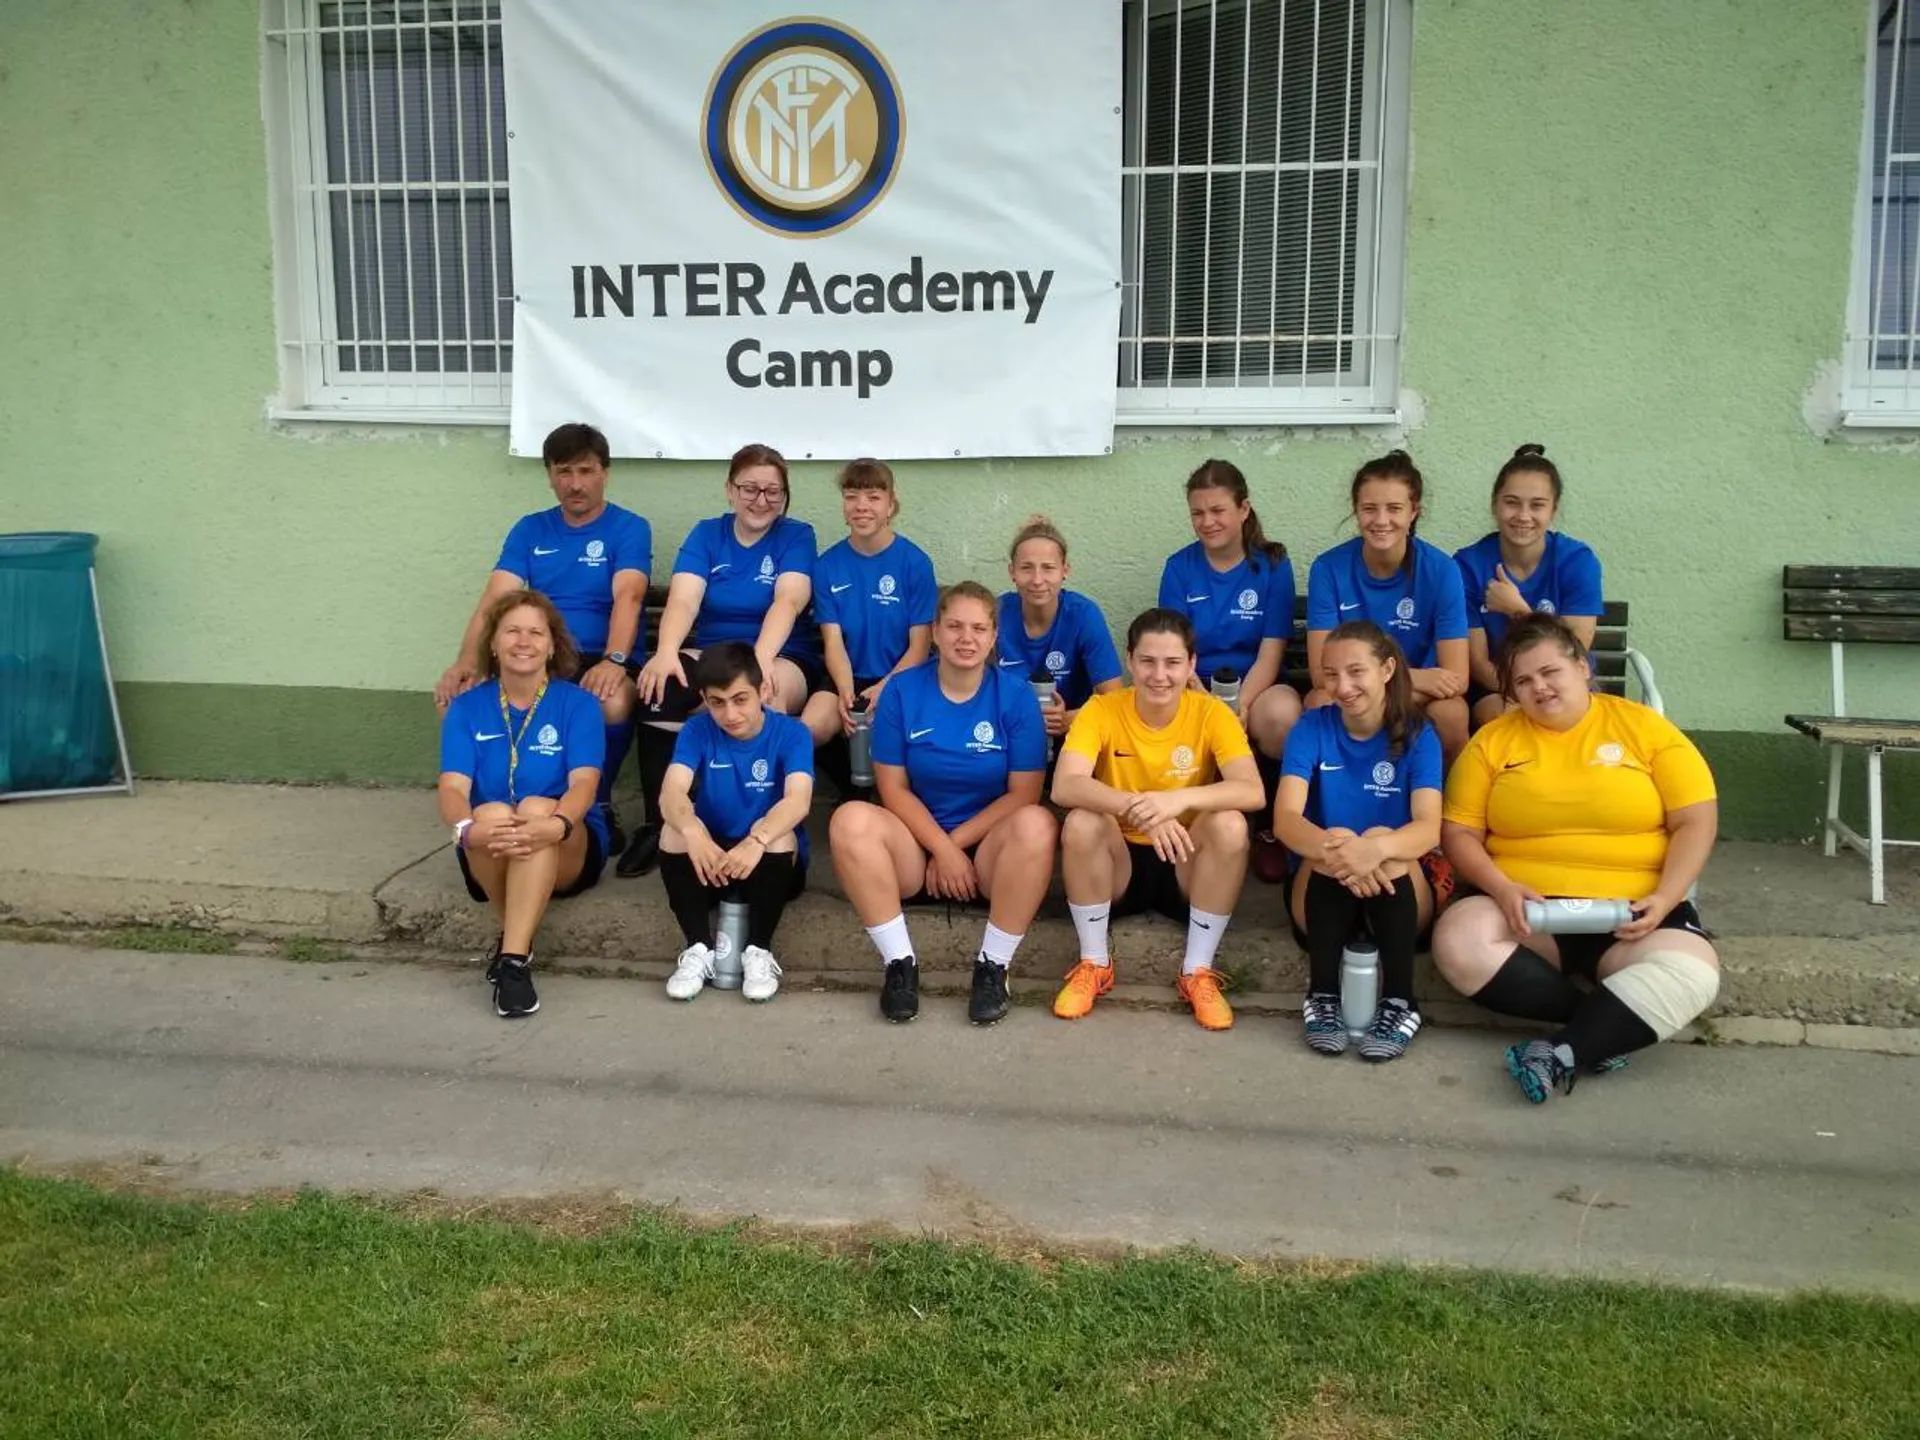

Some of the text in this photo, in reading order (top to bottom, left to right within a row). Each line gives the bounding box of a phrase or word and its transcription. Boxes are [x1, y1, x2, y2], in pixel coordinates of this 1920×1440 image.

[572, 257, 1054, 323] INTER Academy
[727, 339, 892, 398] Camp
